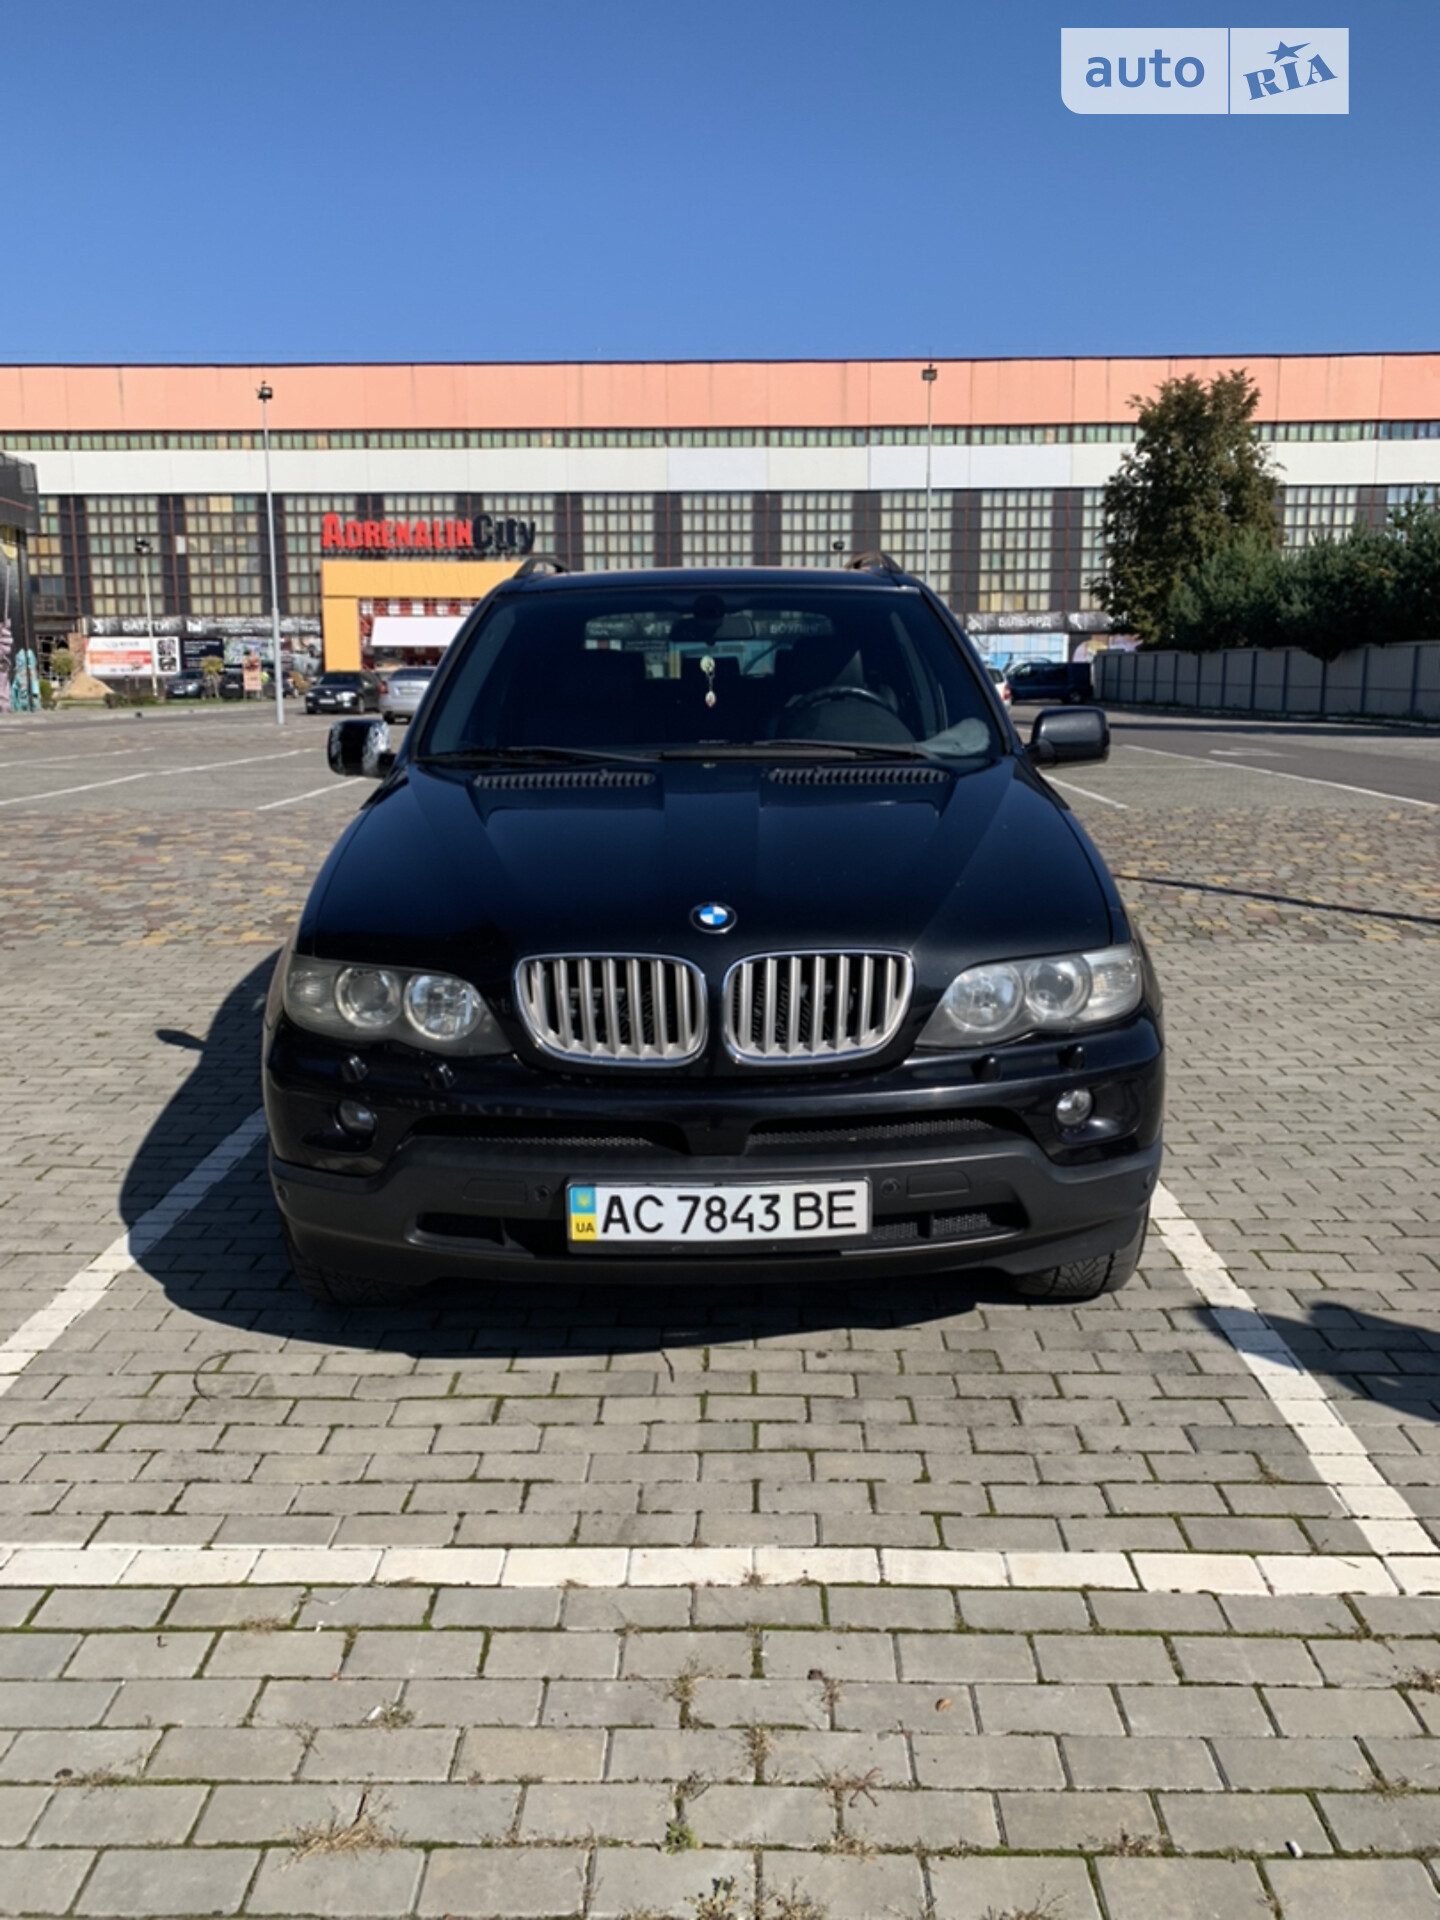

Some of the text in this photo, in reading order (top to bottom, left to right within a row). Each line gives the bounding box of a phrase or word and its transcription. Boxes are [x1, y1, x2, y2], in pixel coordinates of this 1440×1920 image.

[602, 1189, 857, 1235] AC 7843 BE
[576, 1221, 594, 1234] UA
